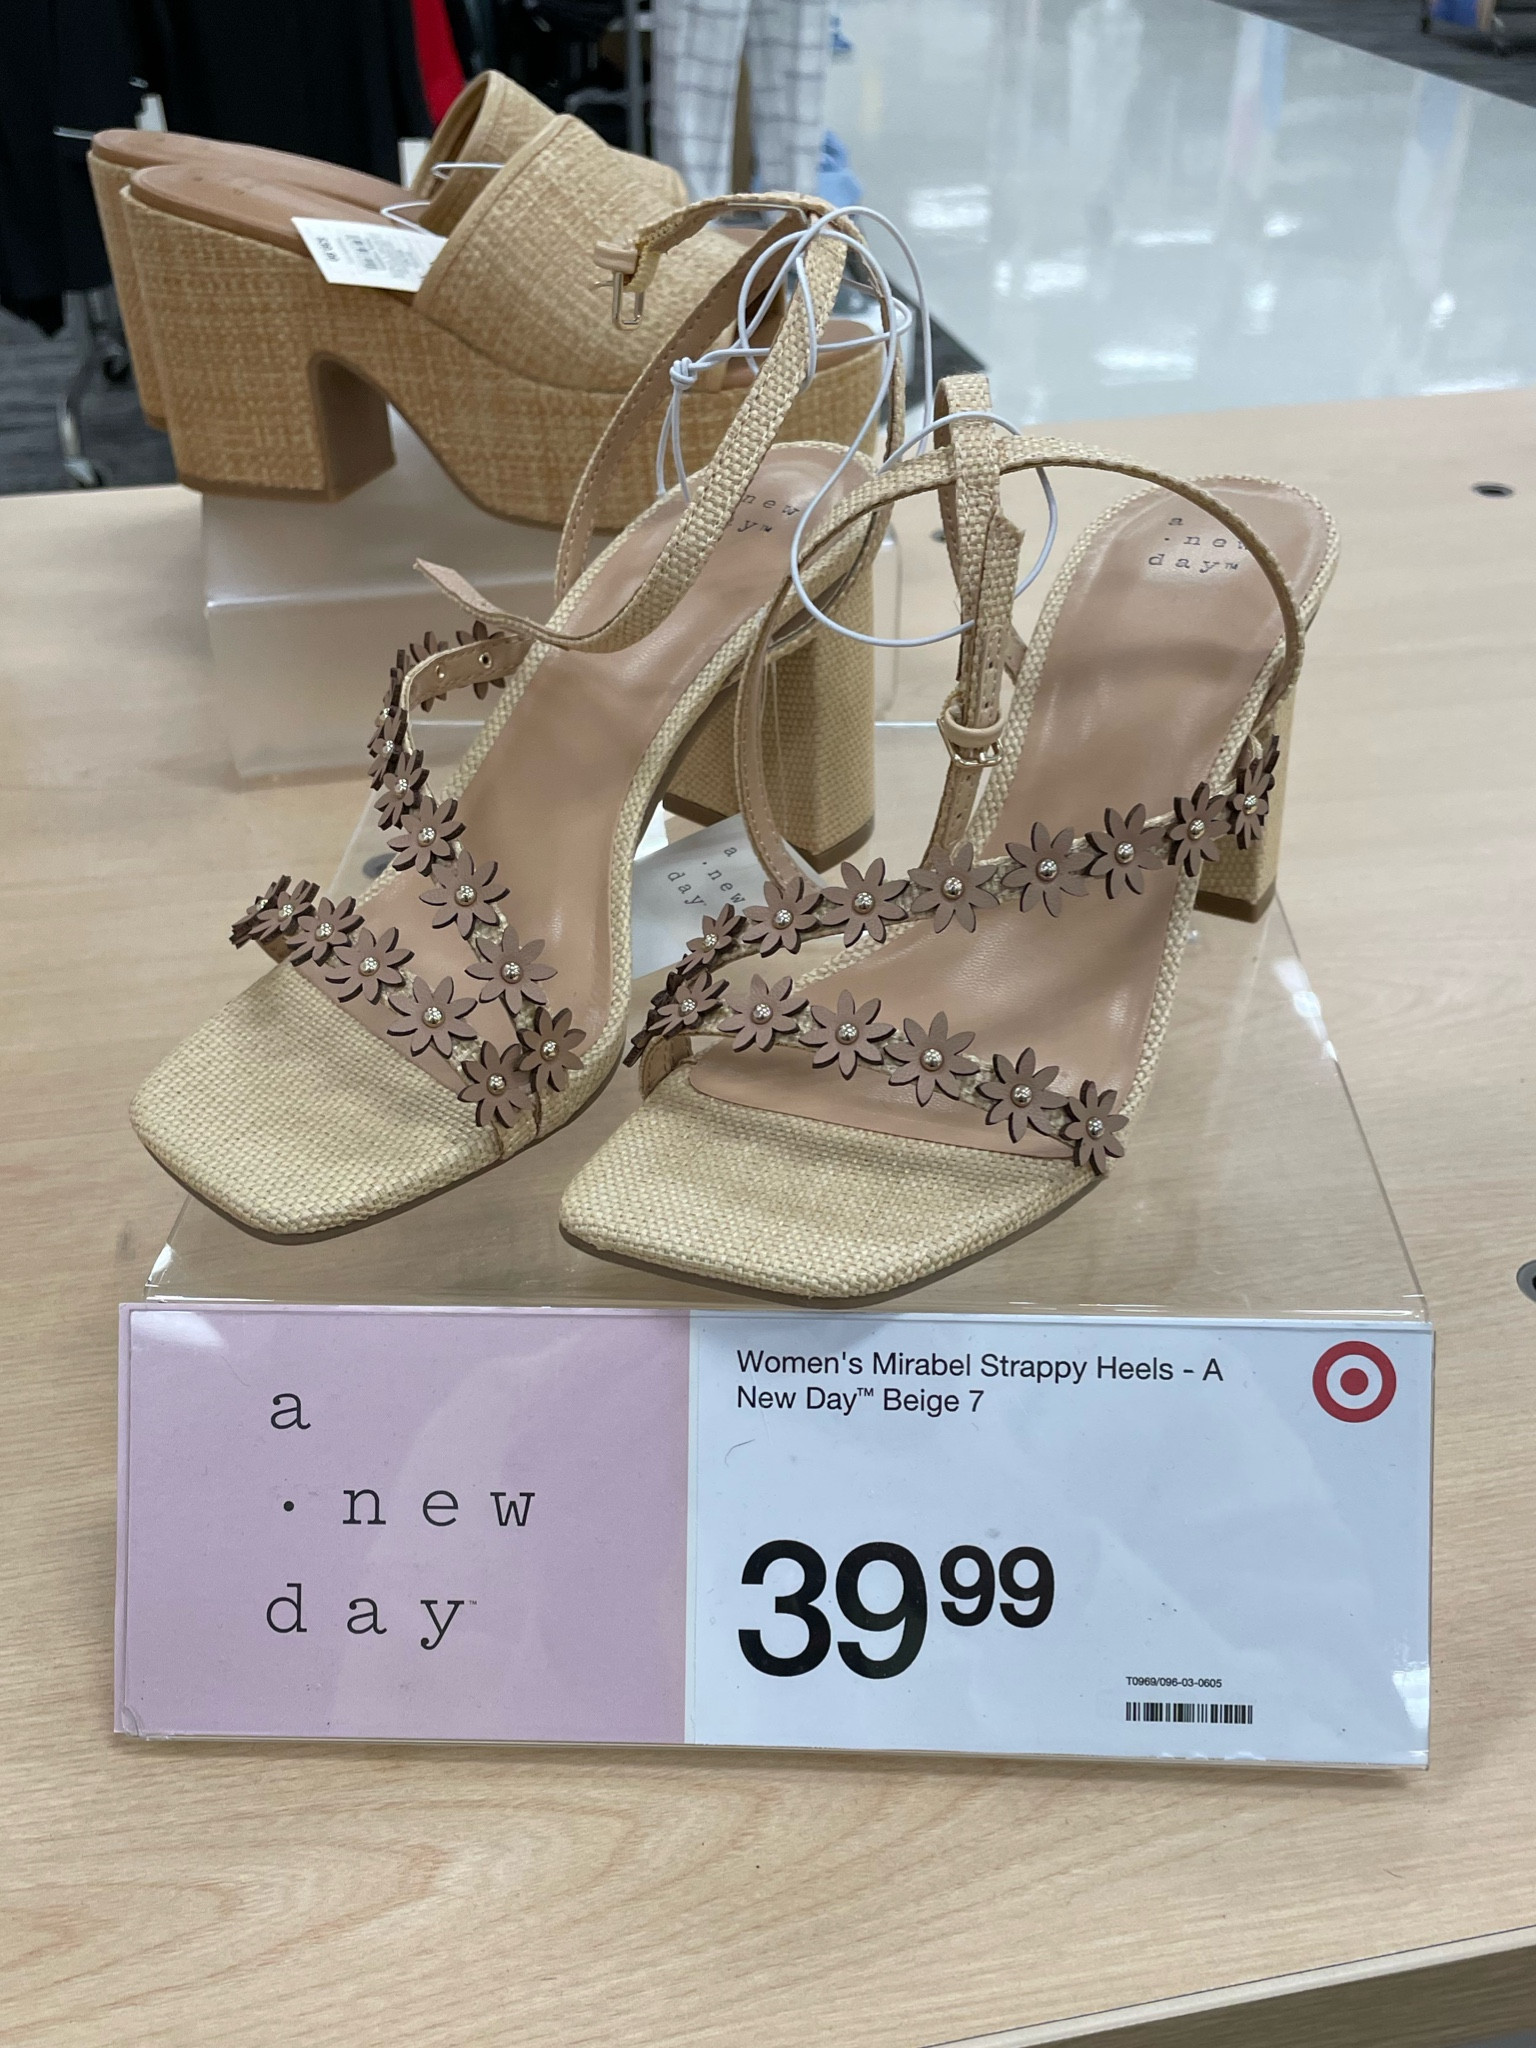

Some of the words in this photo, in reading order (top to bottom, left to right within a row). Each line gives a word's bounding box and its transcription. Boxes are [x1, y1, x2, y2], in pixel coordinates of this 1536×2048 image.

[1168, 517, 1184, 527] a
[723, 846, 738, 858] a
[708, 869, 746, 905] new
[737, 1350, 863, 1375] Women's
[873, 1351, 971, 1377] Mirabel
[980, 1353, 1088, 1385] Strappy
[1097, 1356, 1174, 1381] Heels
[1202, 1358, 1224, 1382] A
[270, 1393, 312, 1430] a
[737, 1385, 797, 1409] New
[883, 1387, 960, 1418] Beige
[969, 1389, 984, 1412] 7
[342, 1489, 536, 1527] new
[1125, 1676, 1223, 1689] T0969/096-03-0605
